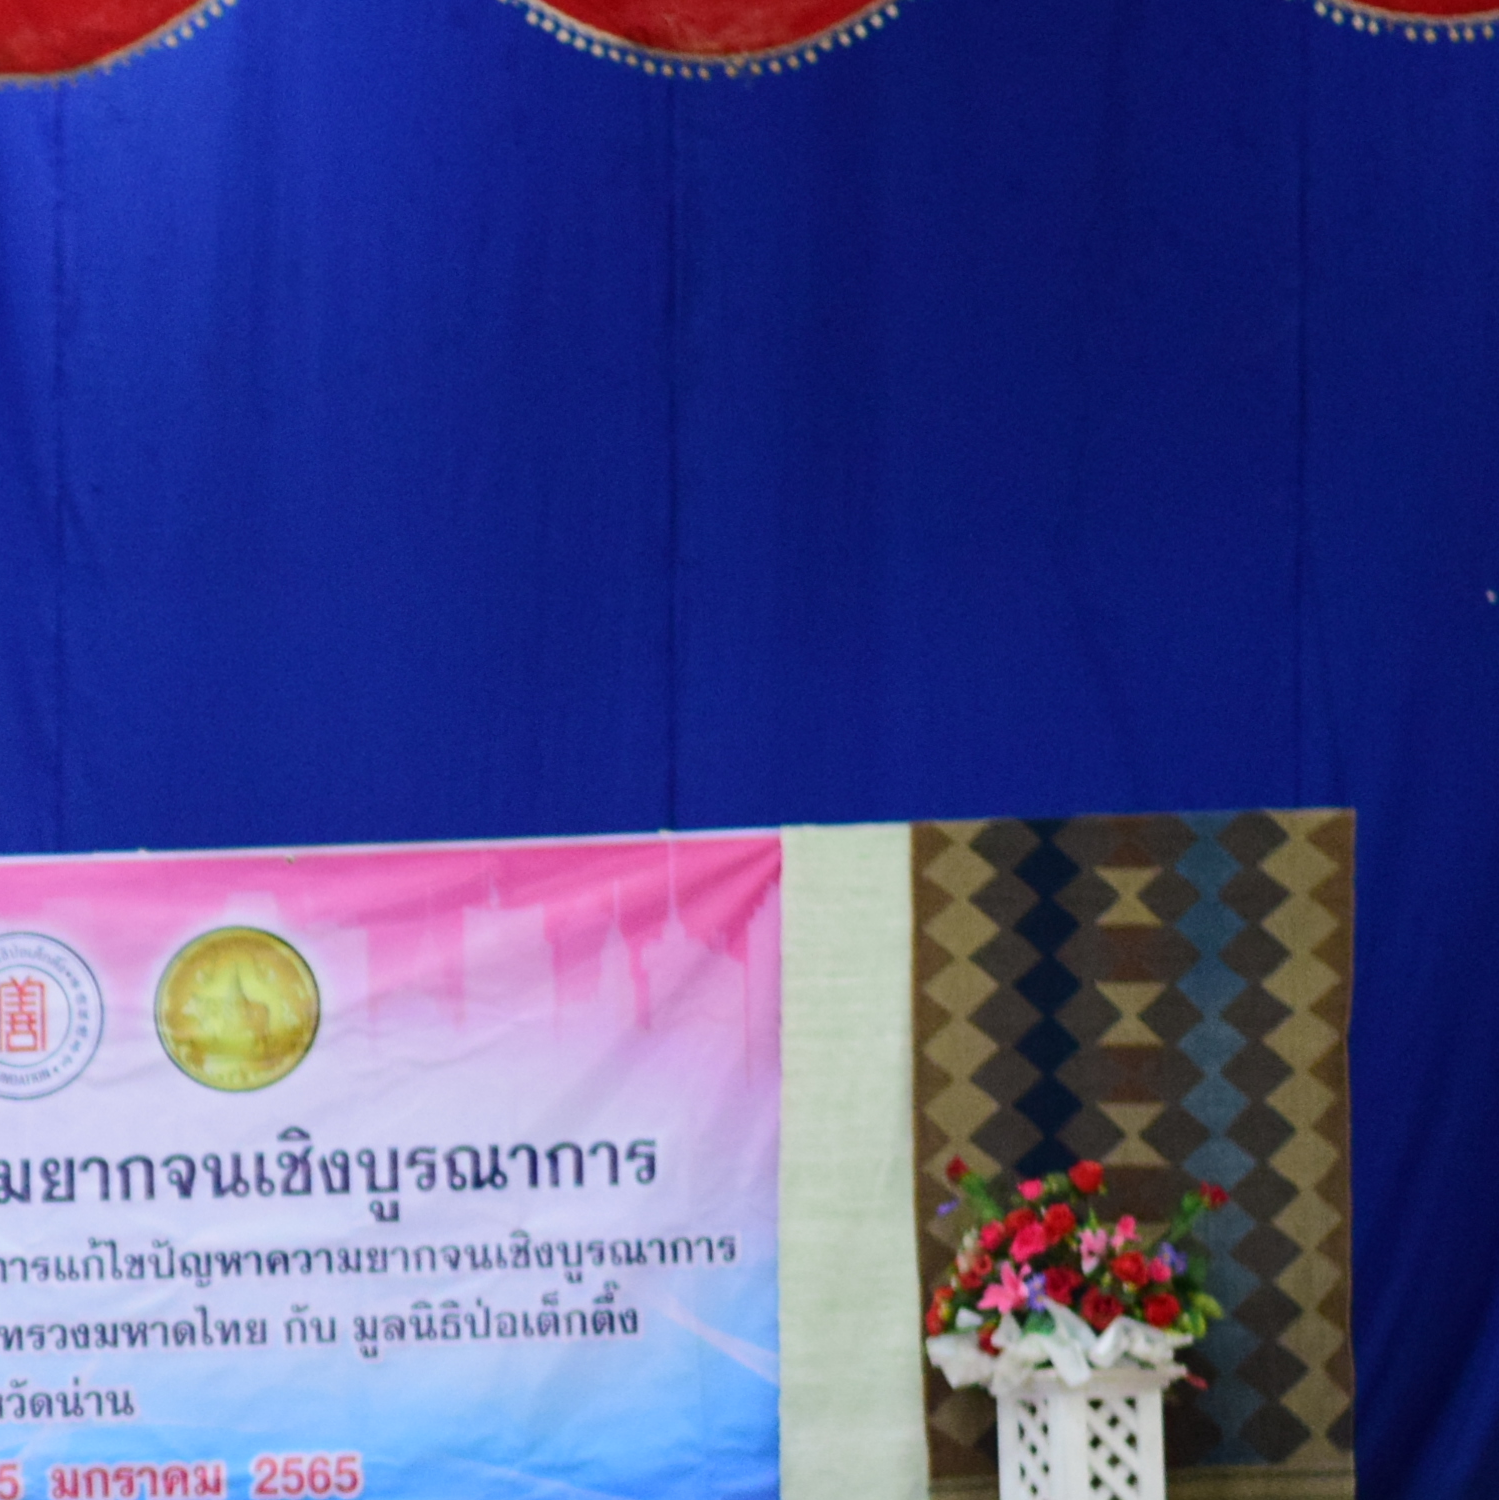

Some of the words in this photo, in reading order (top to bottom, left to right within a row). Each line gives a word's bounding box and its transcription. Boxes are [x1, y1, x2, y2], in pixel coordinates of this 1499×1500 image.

[284, 1303, 338, 1346] กับ
[51, 1460, 225, 1499] มกราคม
[253, 1454, 361, 1496] 2565
